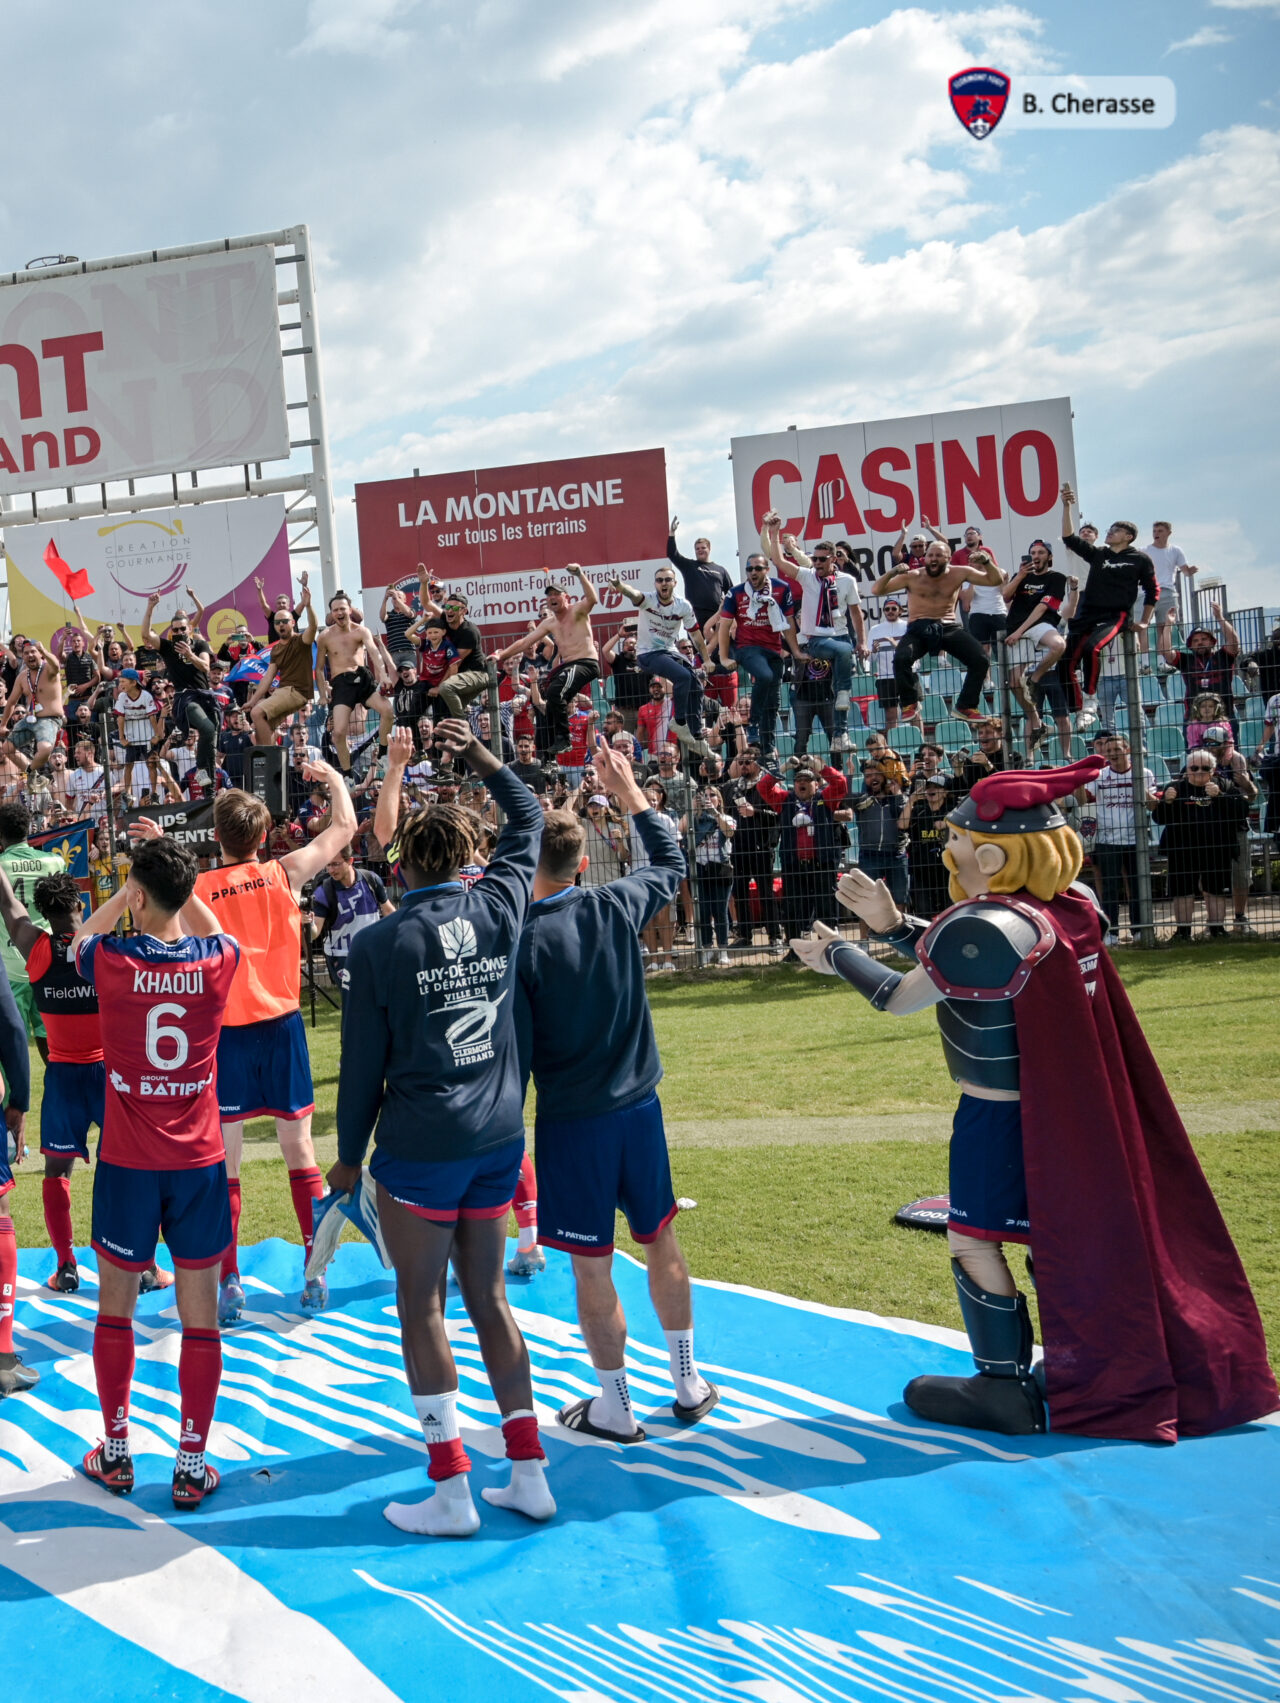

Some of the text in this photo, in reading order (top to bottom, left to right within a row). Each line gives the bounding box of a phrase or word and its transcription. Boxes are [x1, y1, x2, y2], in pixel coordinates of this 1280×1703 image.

[752, 429, 1059, 541] CASINO
[397, 478, 624, 528] LA MONTAGNE
[437, 517, 587, 548] sur tous les terrains
[105, 537, 191, 554] CREATION
[106, 552, 192, 569] GOURMANDE
[560, 576, 575, 587] en
[621, 569, 641, 580] sur
[158, 811, 188, 828] IDS
[221, 876, 273, 898] PATRICK
[416, 955, 508, 985] PUY-DE-DÔME
[43, 985, 100, 999] FieldWi
[419, 984, 429, 995] LE
[444, 986, 487, 1002] VILLE DE
[145, 1002, 189, 1071] 6
[452, 1041, 493, 1058] CLERMONT
[454, 1050, 495, 1067] FERRAND
[565, 1231, 598, 1242] PATRICK
[107, 1241, 134, 1257] PATRICK
